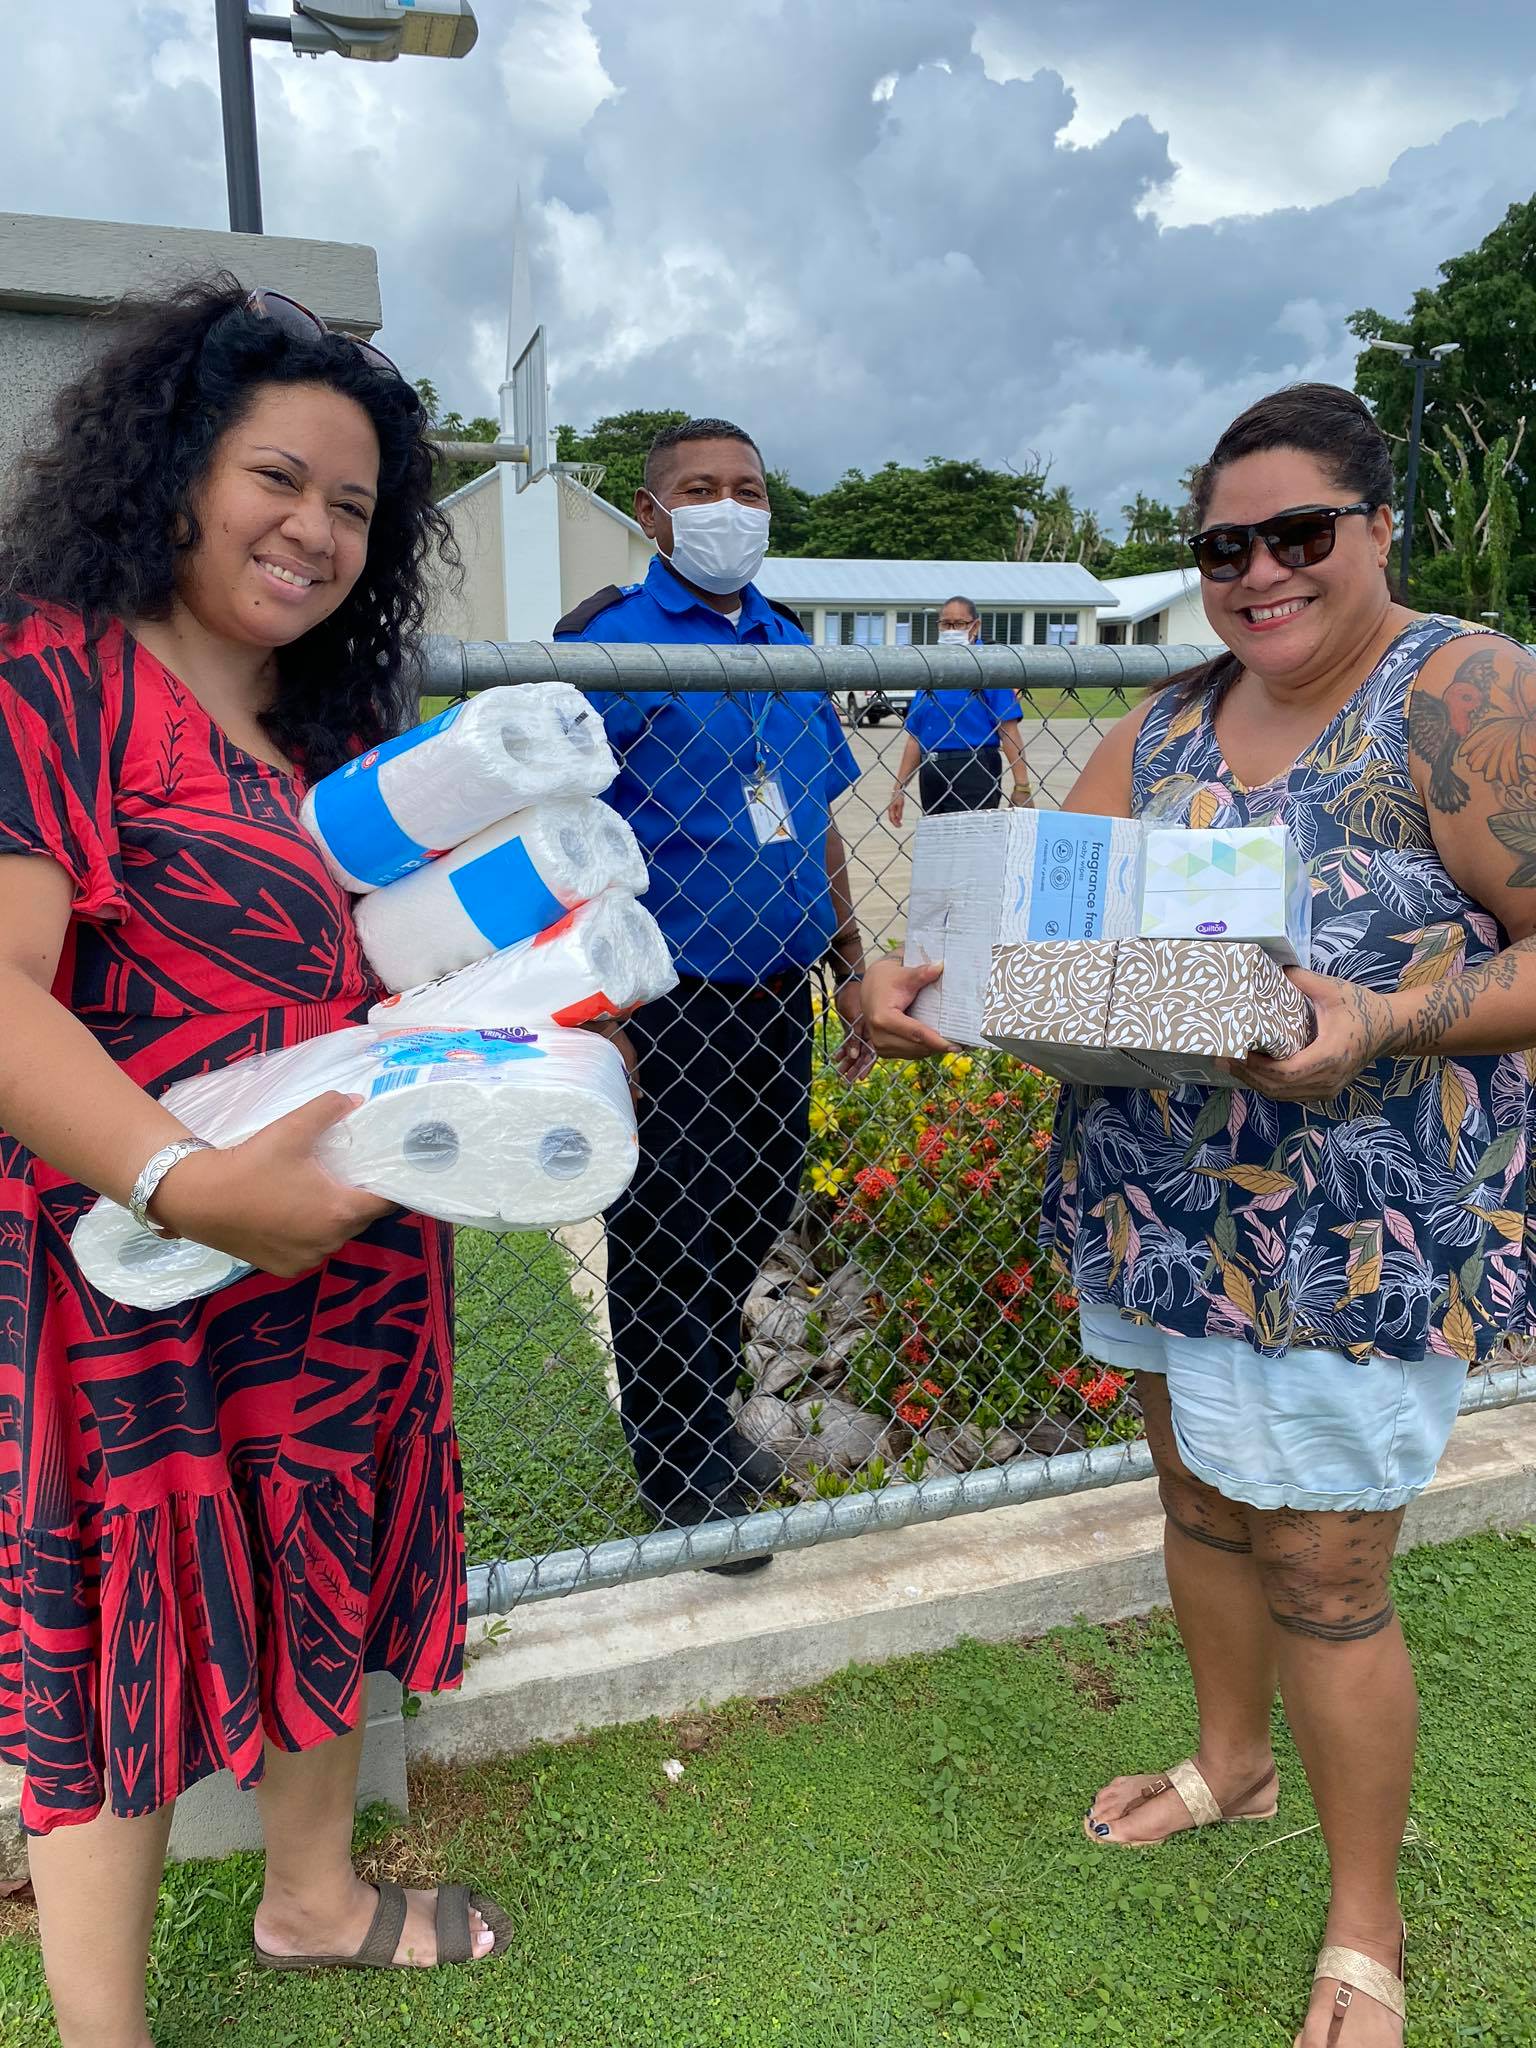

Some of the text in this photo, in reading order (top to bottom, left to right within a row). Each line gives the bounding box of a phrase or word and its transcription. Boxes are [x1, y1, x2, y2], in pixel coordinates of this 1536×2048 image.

[1084, 842, 1103, 938] fragrance free
[1197, 923, 1224, 933] Quilton
[484, 1030, 506, 1039] TRIPLE
